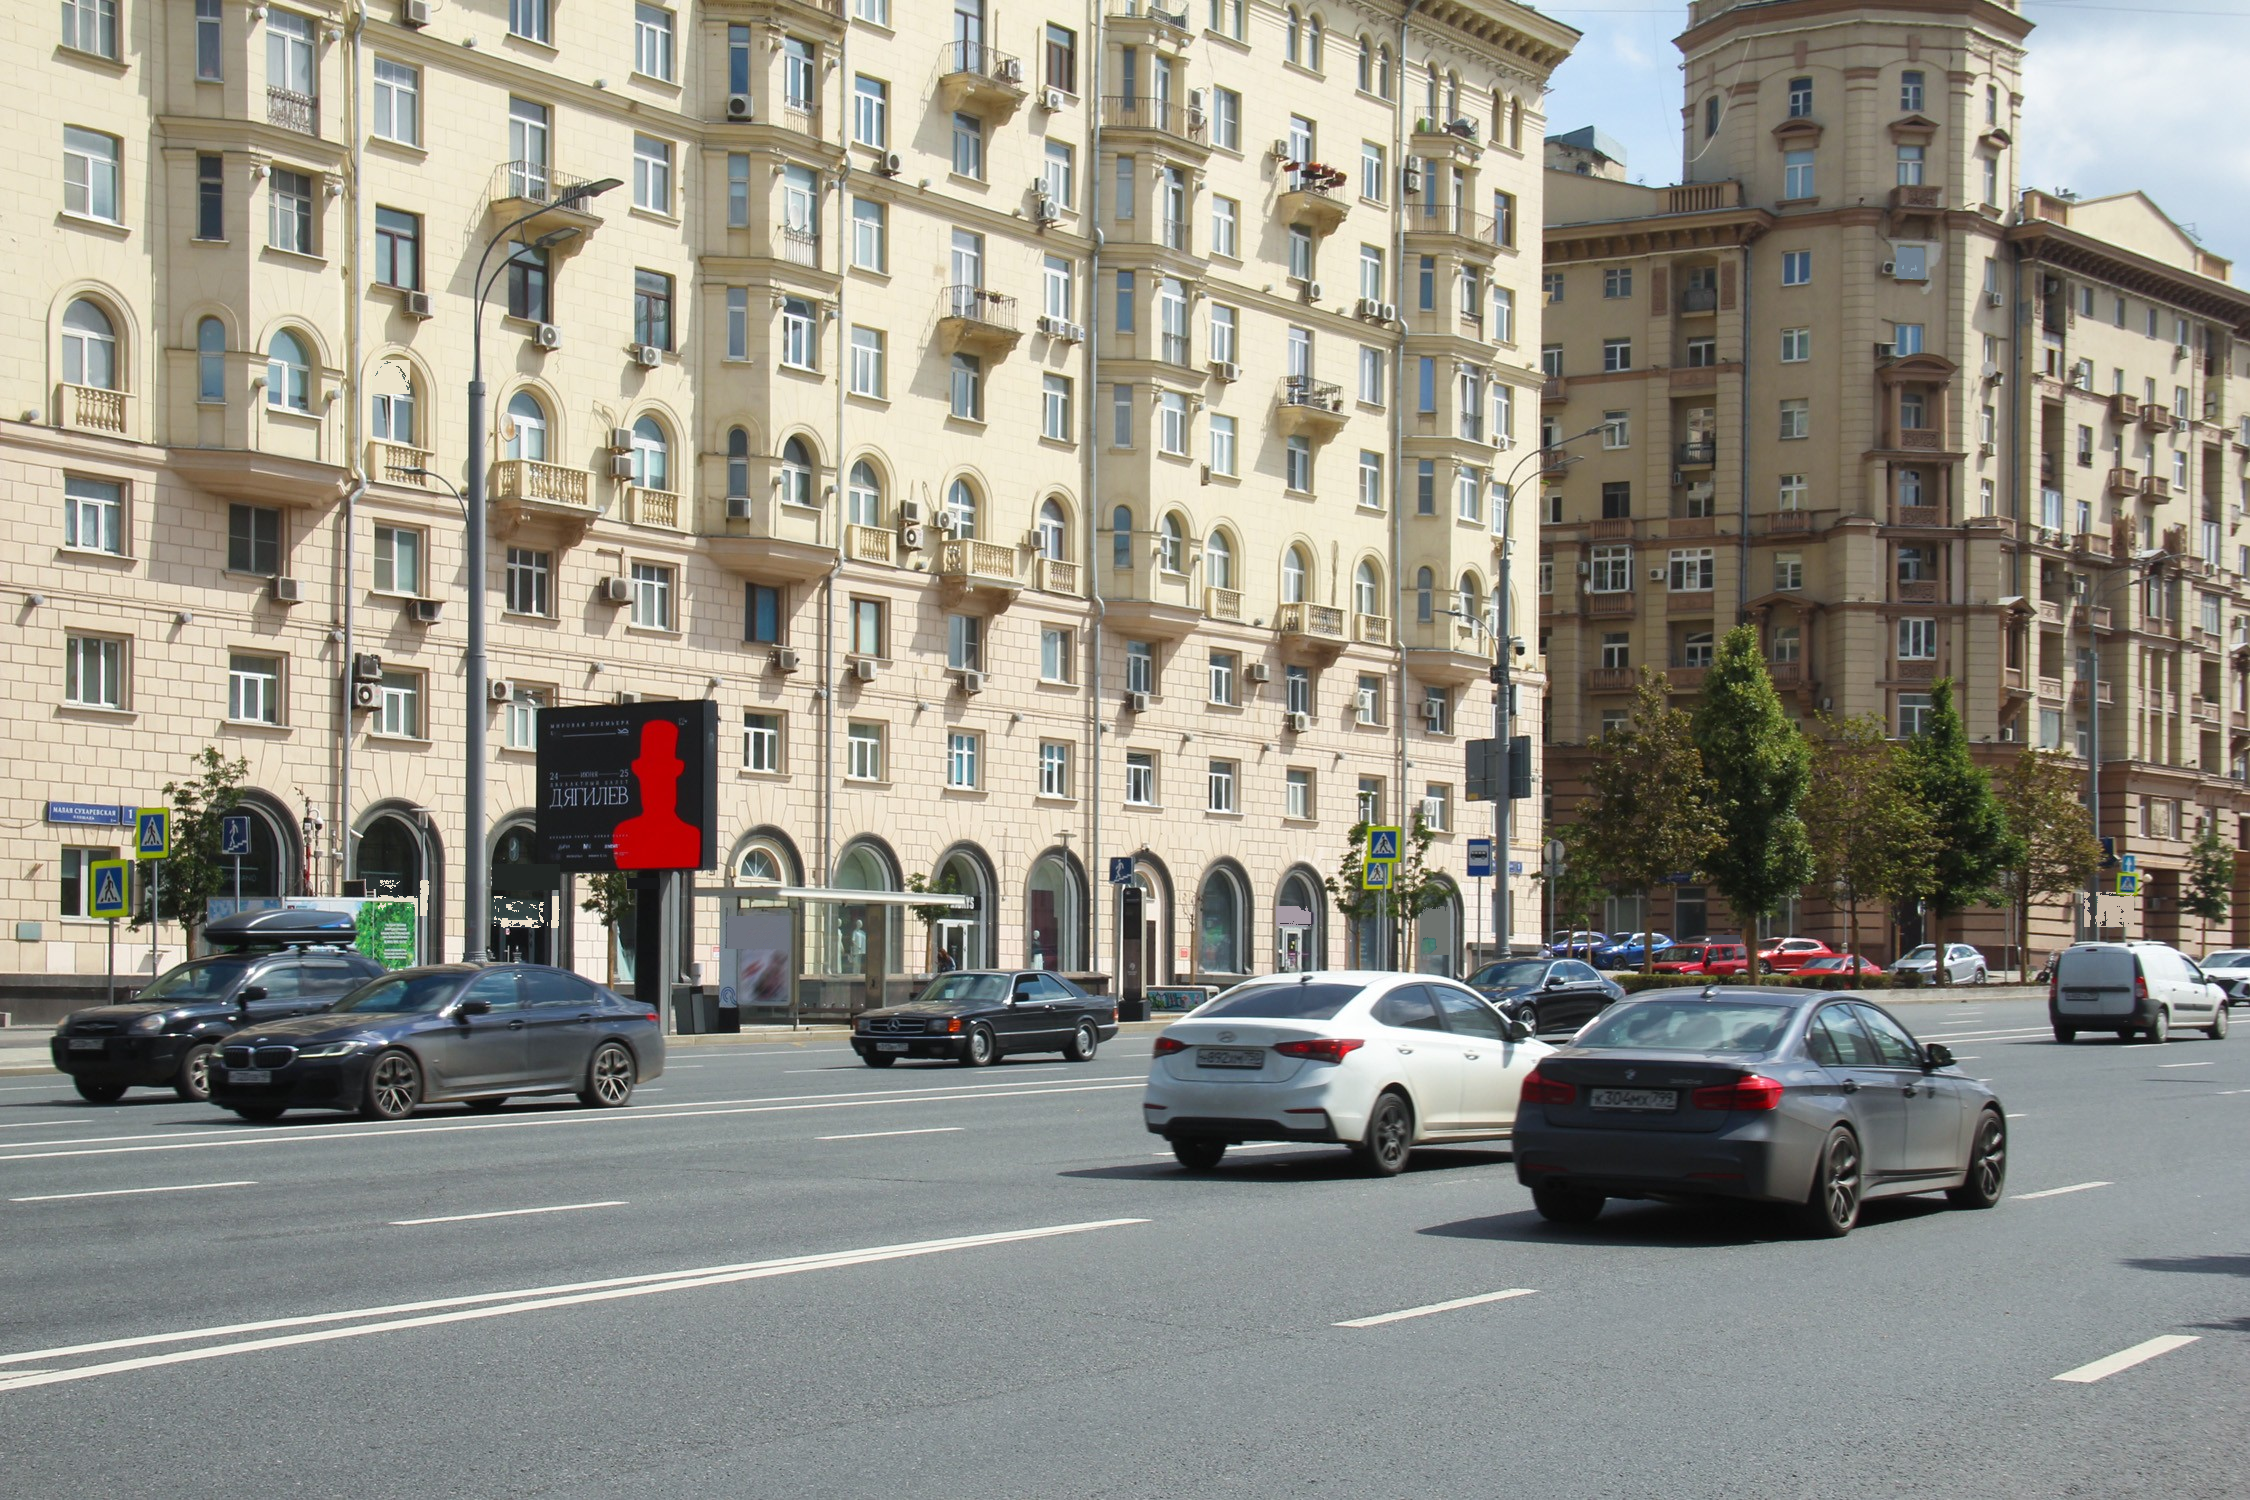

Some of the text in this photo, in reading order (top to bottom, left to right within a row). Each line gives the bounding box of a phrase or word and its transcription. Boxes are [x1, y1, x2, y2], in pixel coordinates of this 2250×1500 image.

[549, 772, 559, 781] 24
[619, 768, 629, 778] 25
[549, 786, 629, 810] ДЯГИЛЕВ
[53, 806, 116, 816] МАЛАЯ СУХАРЕВСКАЯ
